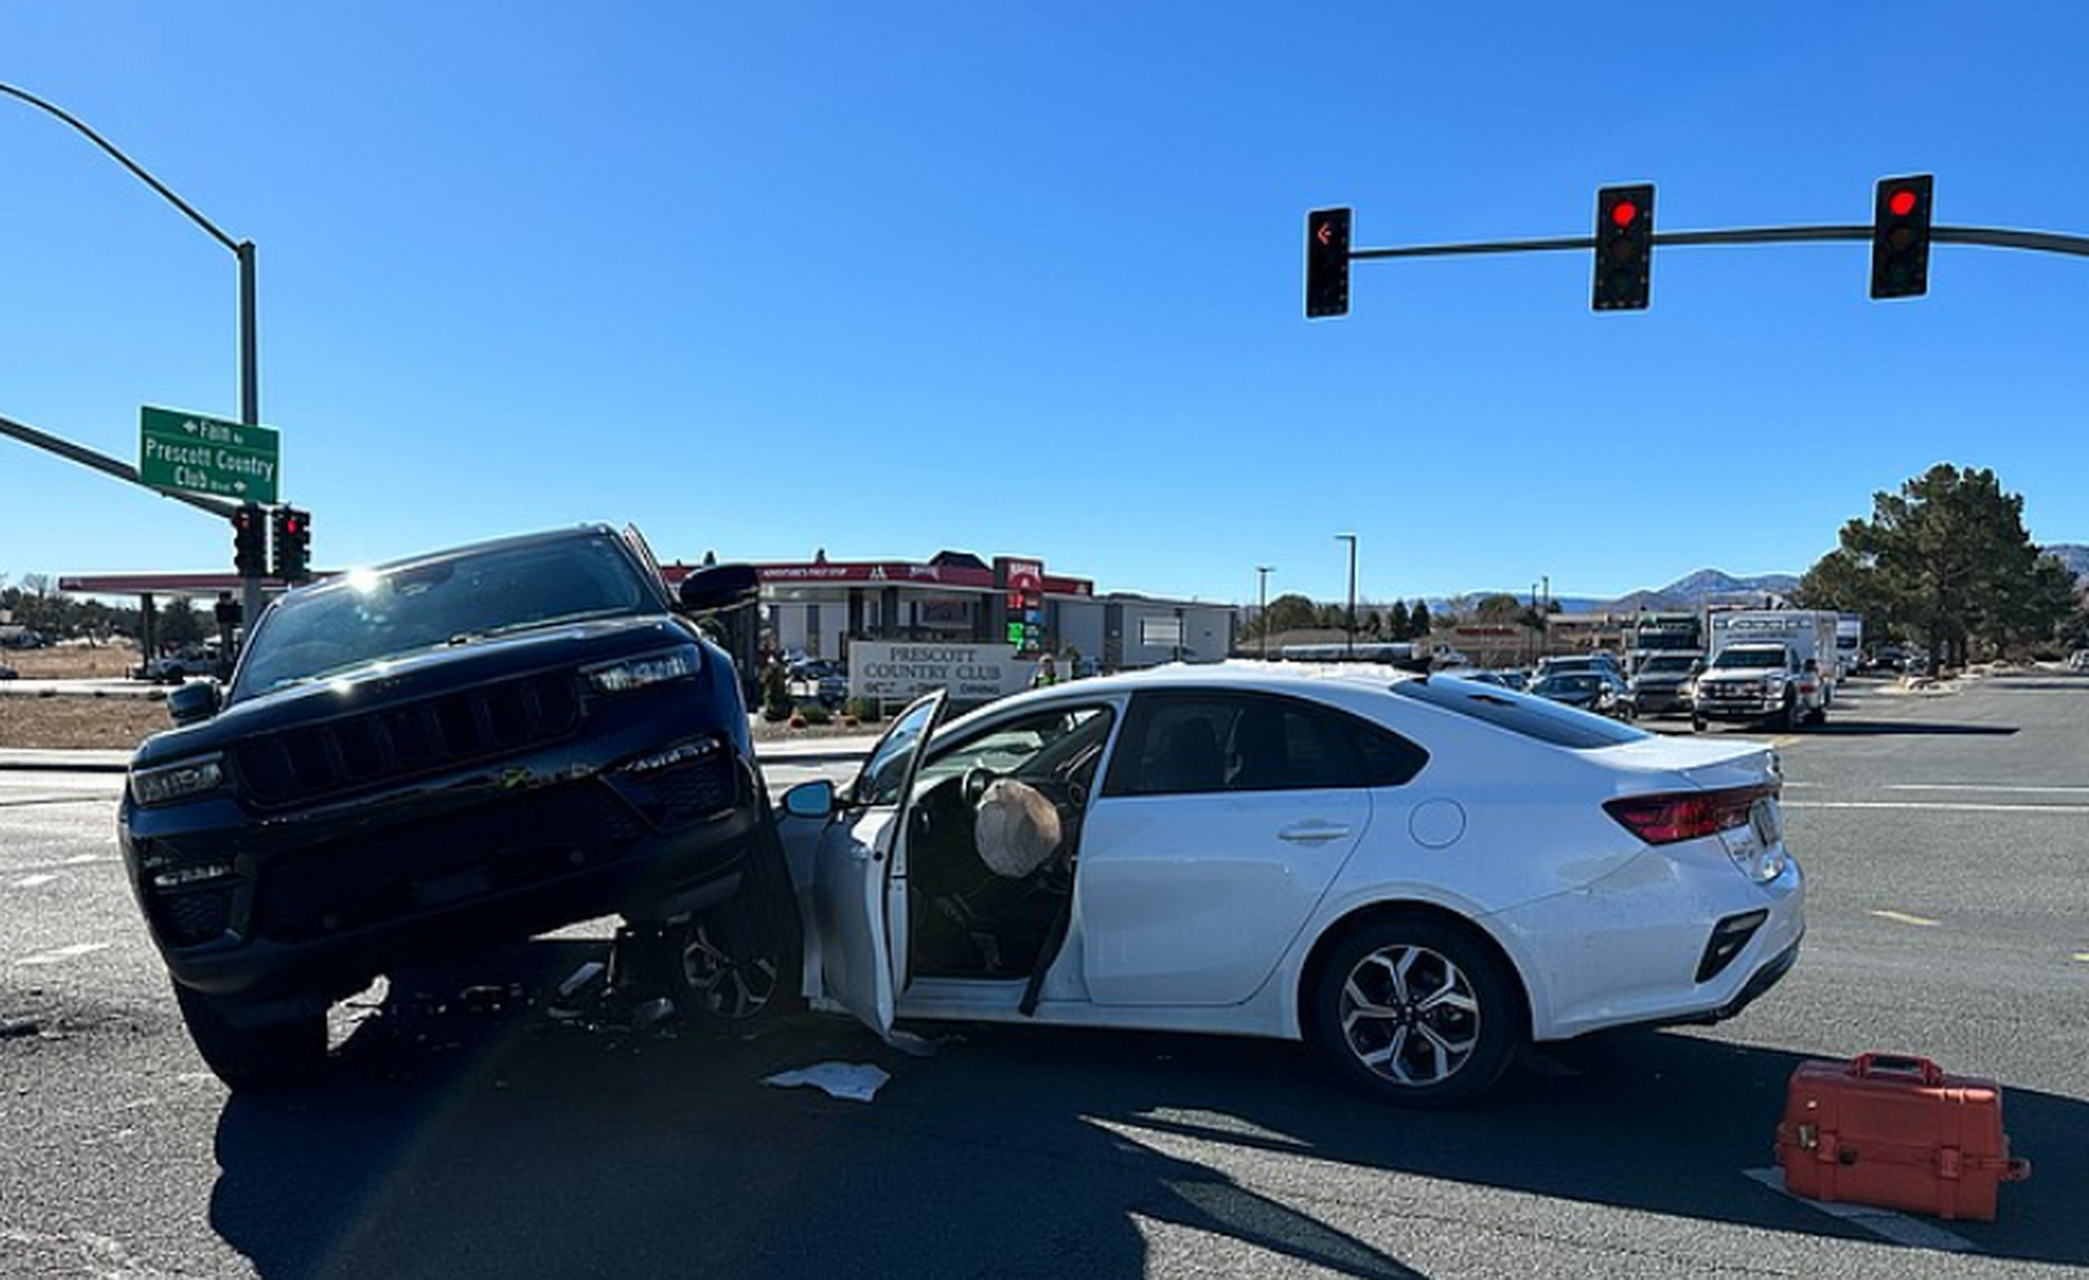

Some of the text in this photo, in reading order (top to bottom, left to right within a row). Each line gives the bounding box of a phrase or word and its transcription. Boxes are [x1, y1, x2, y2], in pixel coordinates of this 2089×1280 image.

[146, 438, 274, 482] Prescott Country
[174, 465, 207, 489] Club
[890, 646, 976, 663] PRESCOTT
[864, 662, 1001, 680] COUNTRY CLUB
